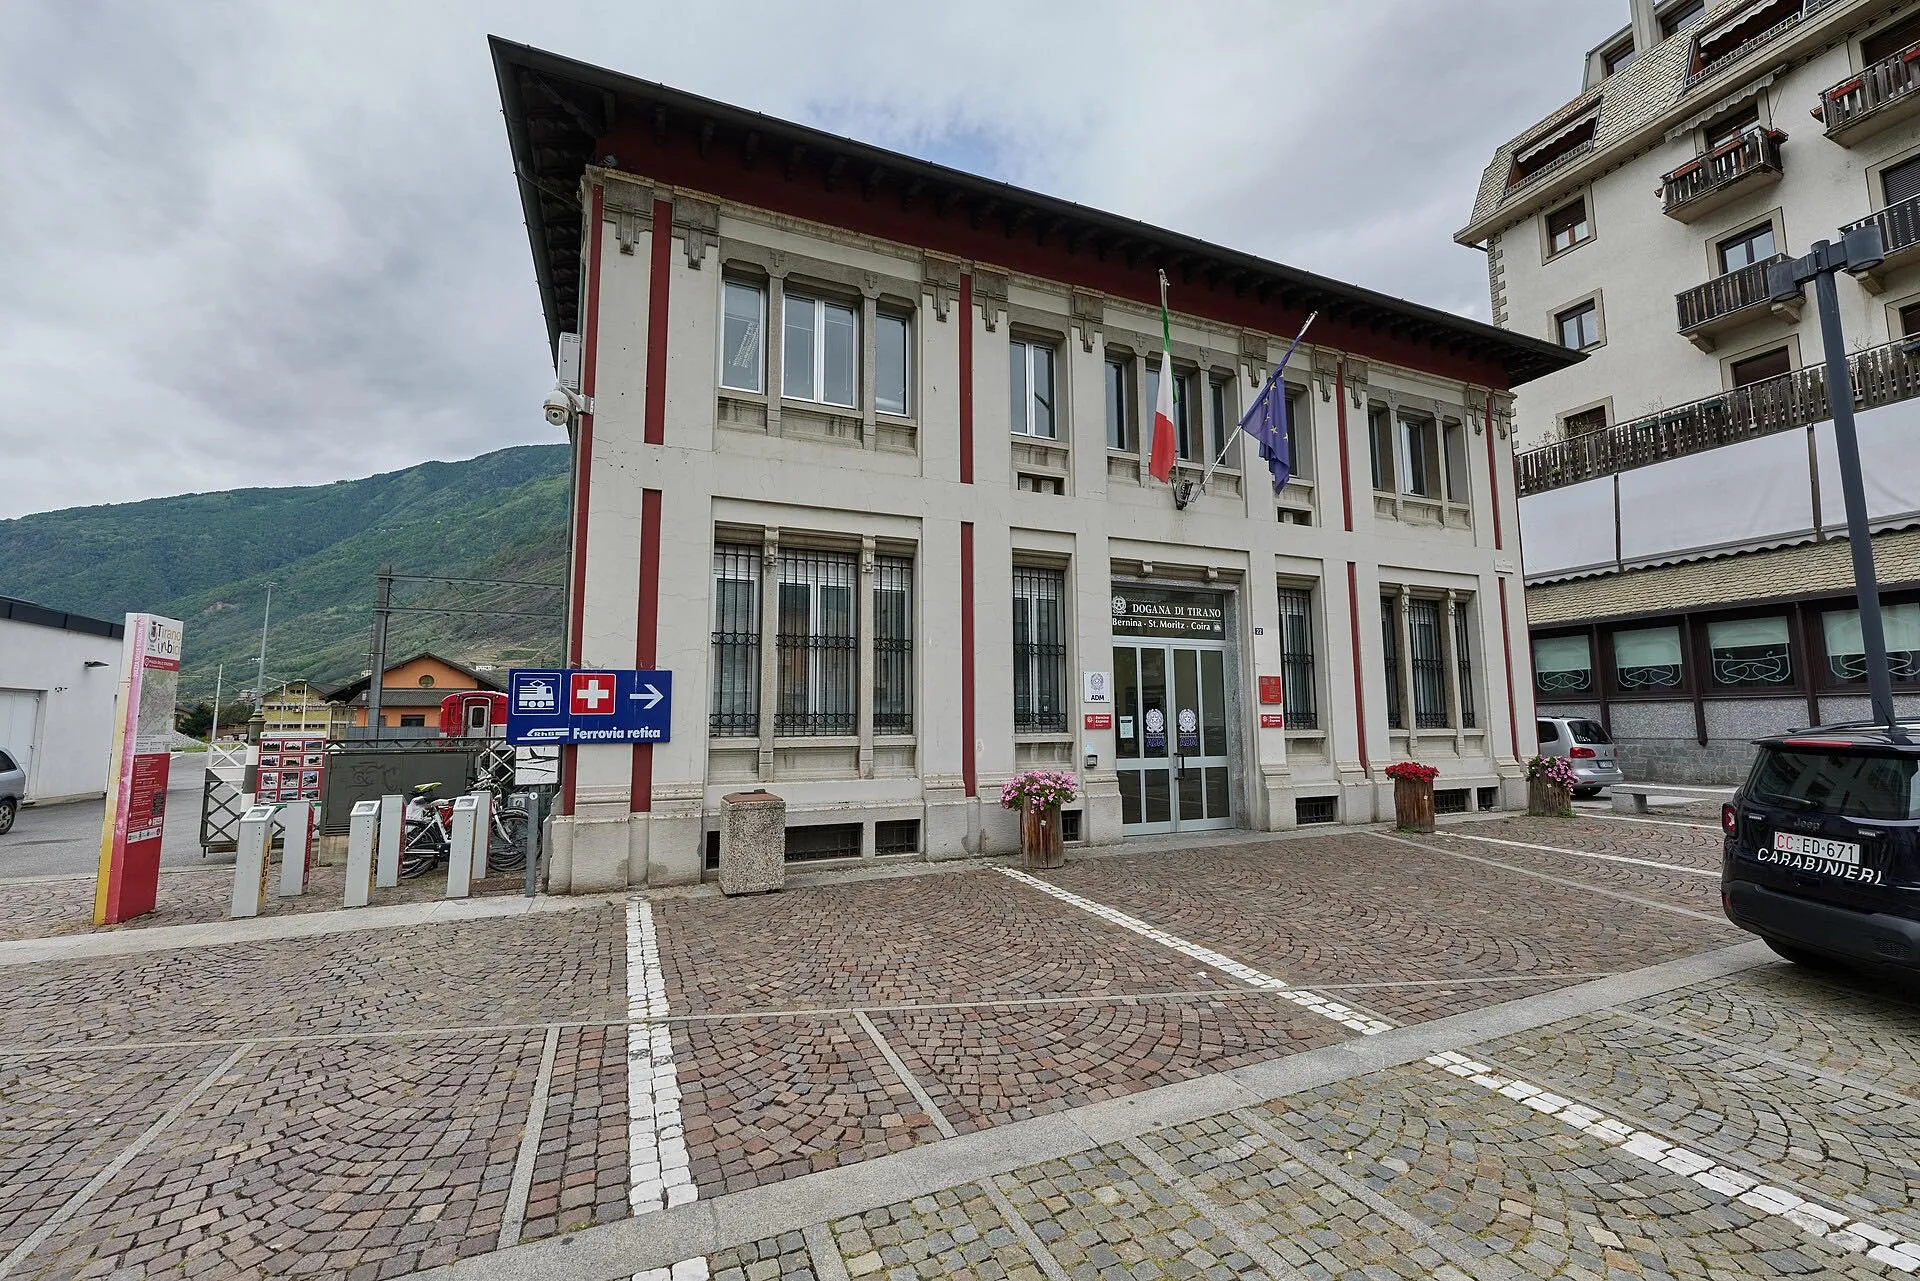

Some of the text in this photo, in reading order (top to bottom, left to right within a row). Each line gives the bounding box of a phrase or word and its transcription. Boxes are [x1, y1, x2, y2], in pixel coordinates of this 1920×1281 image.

[1132, 603, 1221, 618] DOGANA DI TIRANO
[1112, 617, 1142, 628] Bernina
[1191, 621, 1211, 631] Coira
[157, 623, 182, 642] Tirano
[573, 725, 661, 739] Ferrovia retica
[1777, 834, 1793, 850] CC
[1757, 847, 1883, 884] CARABINIERI
